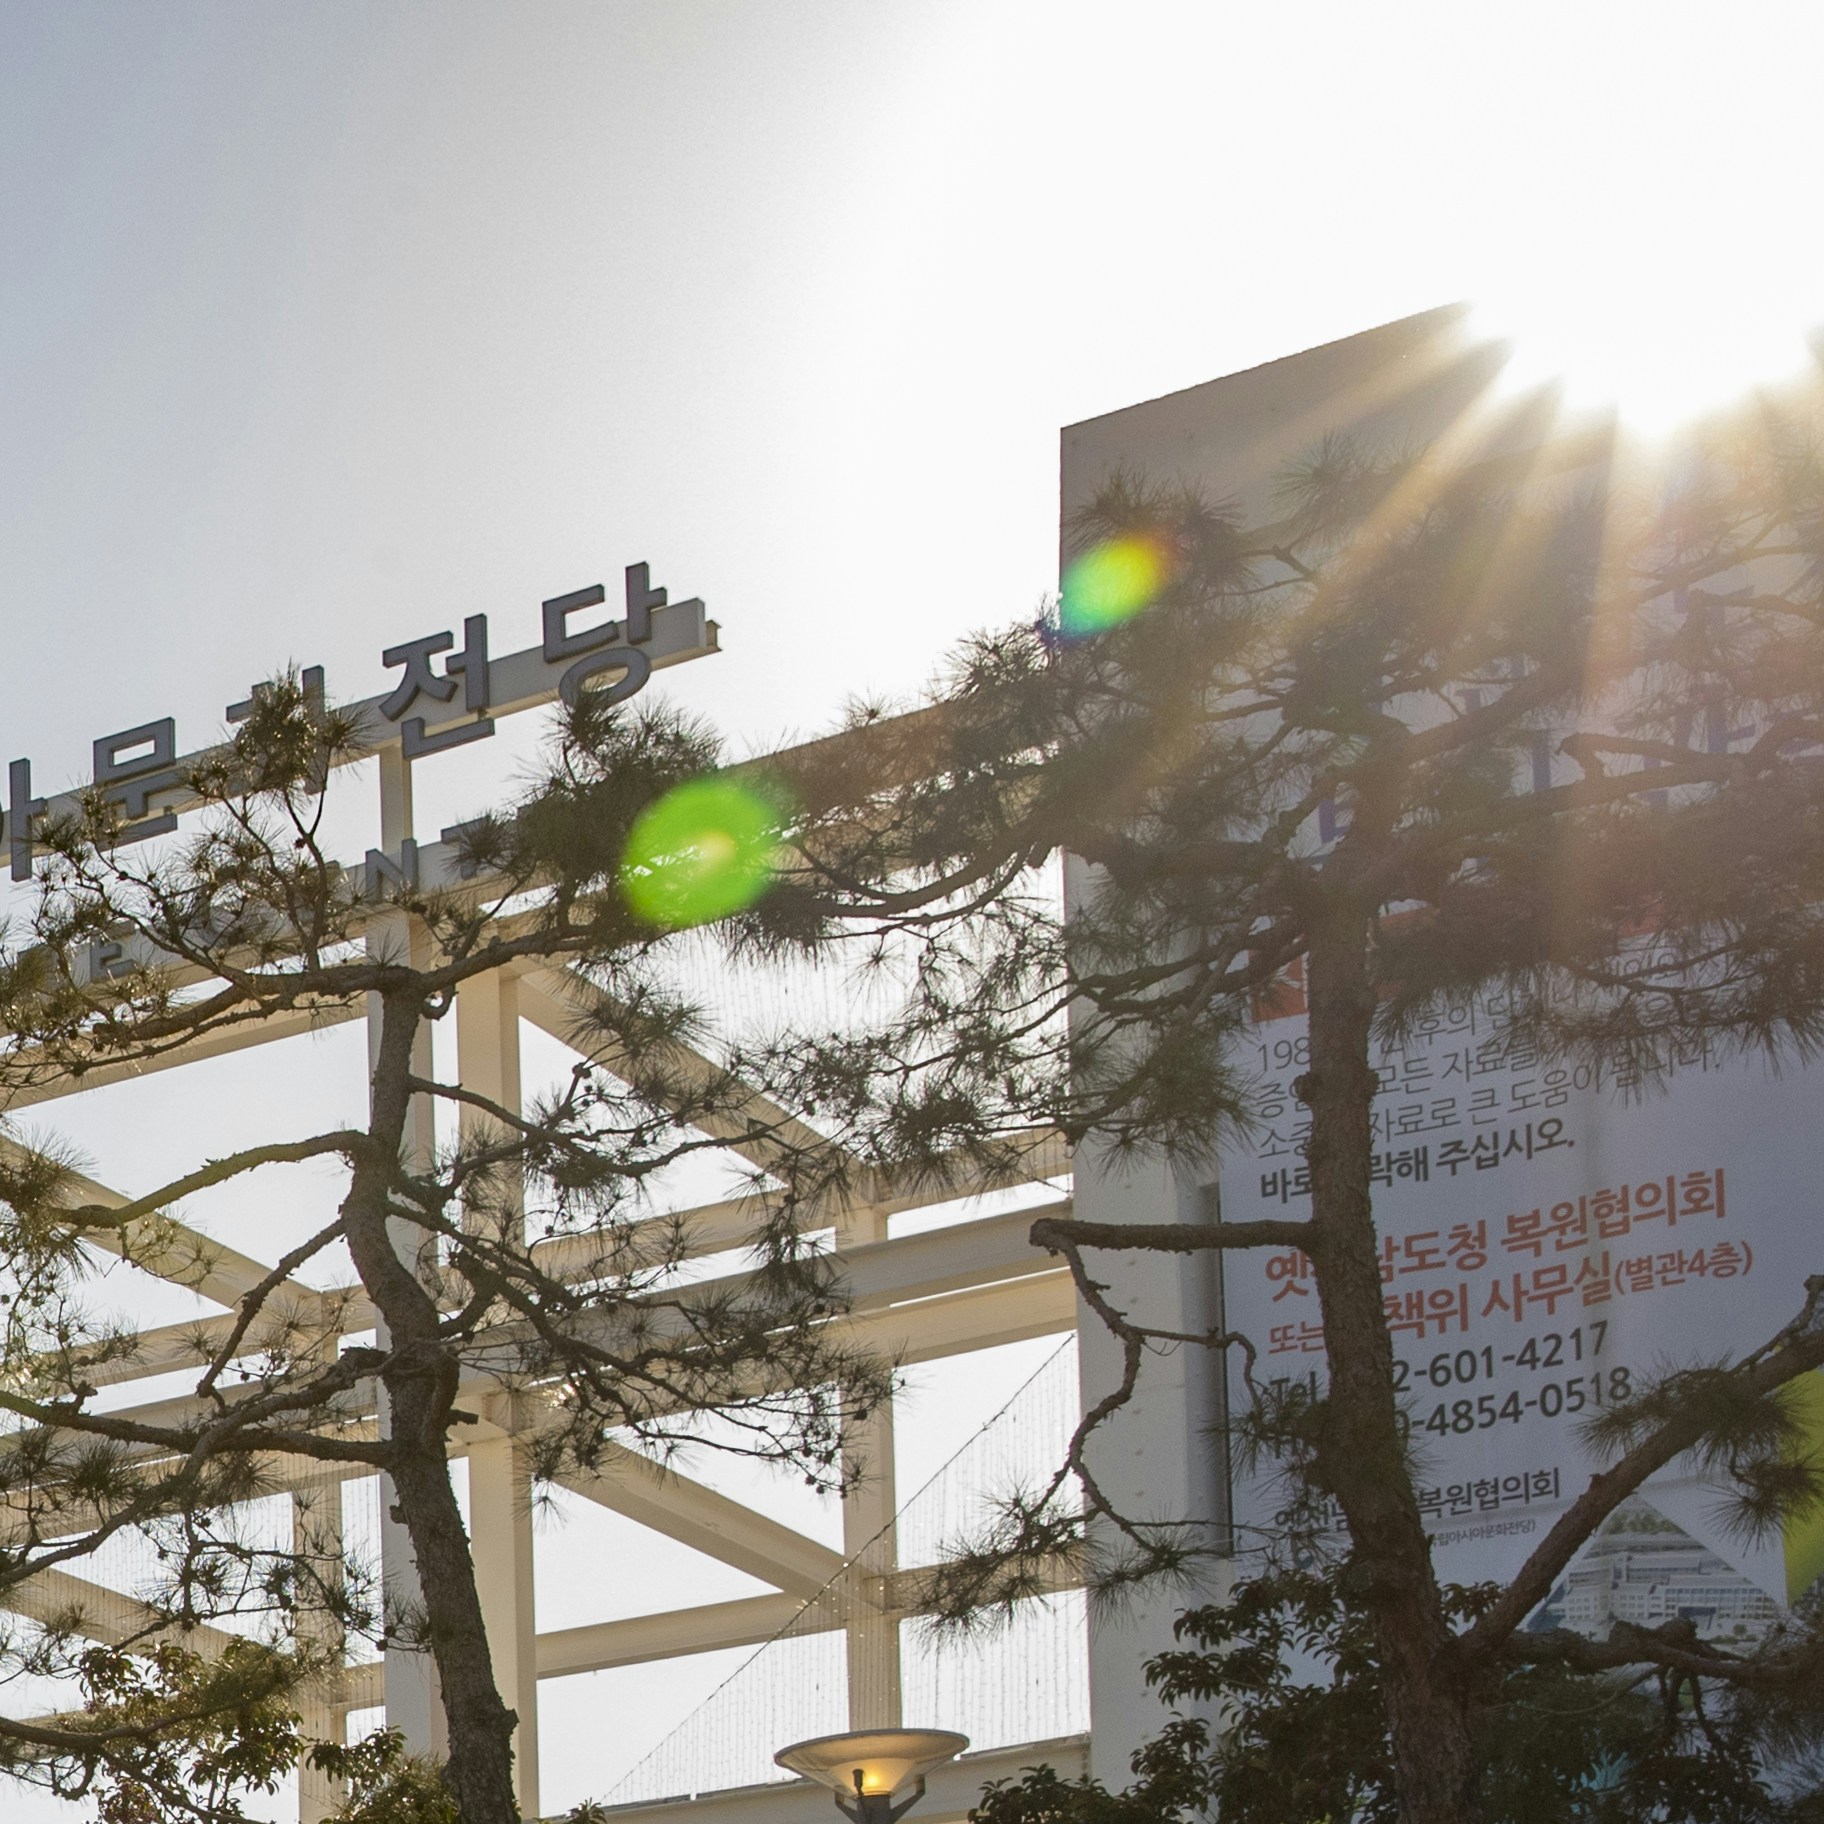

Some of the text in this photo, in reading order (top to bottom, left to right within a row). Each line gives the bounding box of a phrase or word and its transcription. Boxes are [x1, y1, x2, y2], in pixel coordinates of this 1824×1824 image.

[1466, 1087, 1500, 1125] 큰
[1370, 1146, 1430, 1189] 락해
[1436, 1115, 1577, 1176] 주십시오.
[1499, 1167, 1728, 1255] 복원협의회
[1383, 1282, 1469, 1340] 책위
[1392, 1319, 1610, 1394] 2-601-4217
[1394, 1364, 1633, 1438] 0-4854-0518
